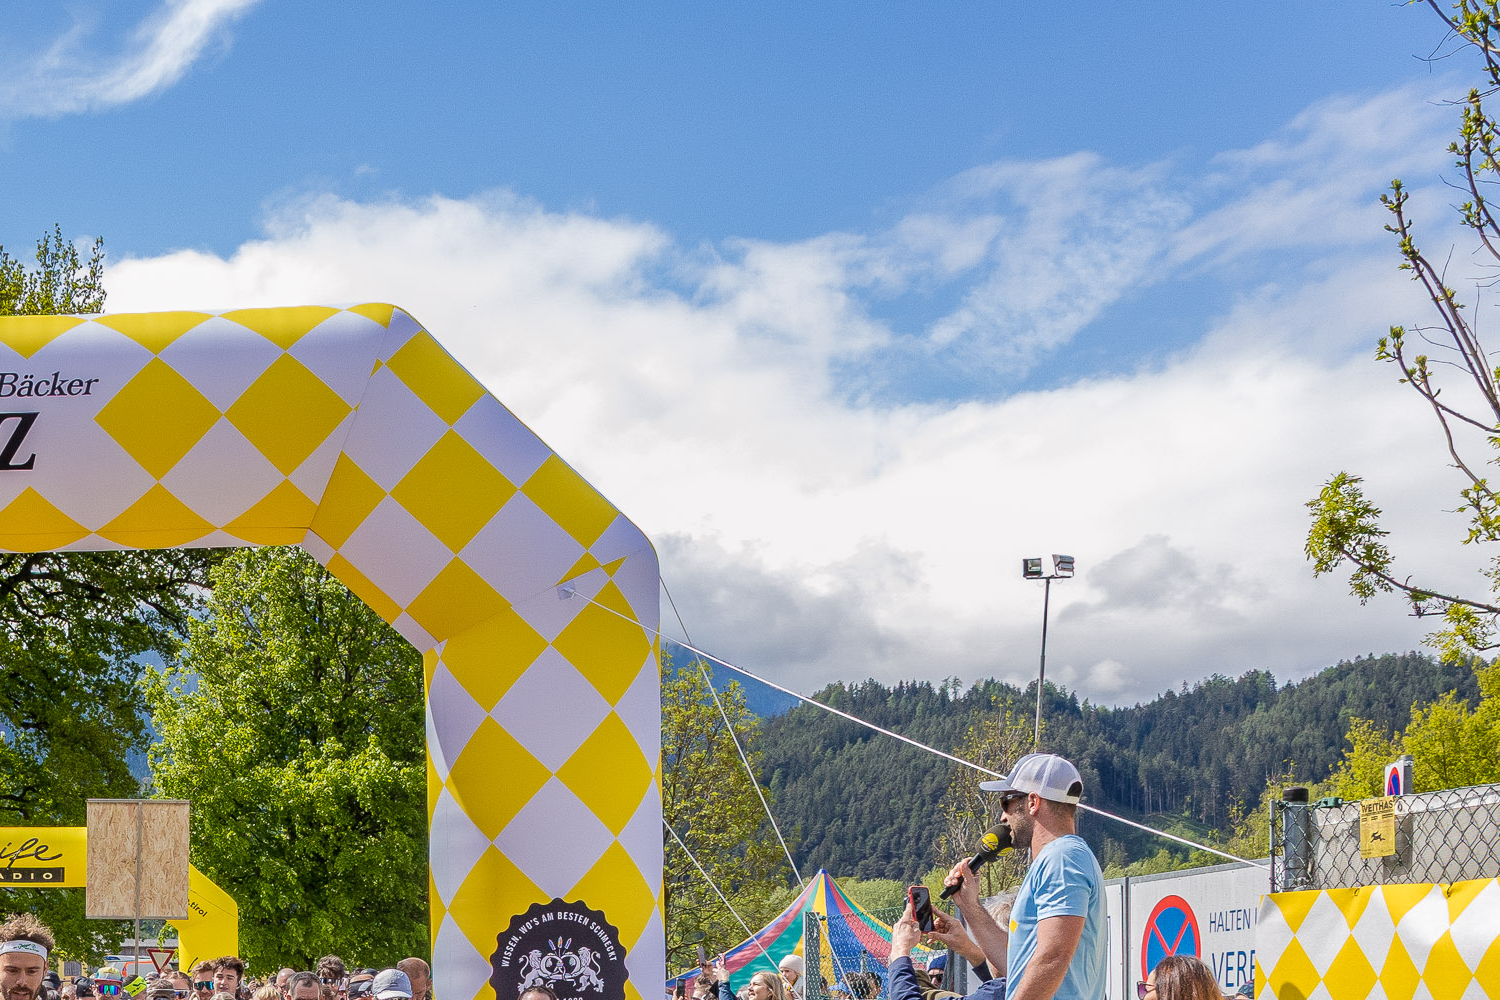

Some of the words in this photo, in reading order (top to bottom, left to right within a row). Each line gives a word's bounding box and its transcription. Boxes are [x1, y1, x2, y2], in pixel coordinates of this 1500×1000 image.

[518, 917, 540, 935] WO'S
[541, 912, 554, 923] AM
[557, 911, 590, 926] BESTEN
[589, 921, 618, 962] SCHMECKT
[1208, 908, 1251, 934] HALTEN
